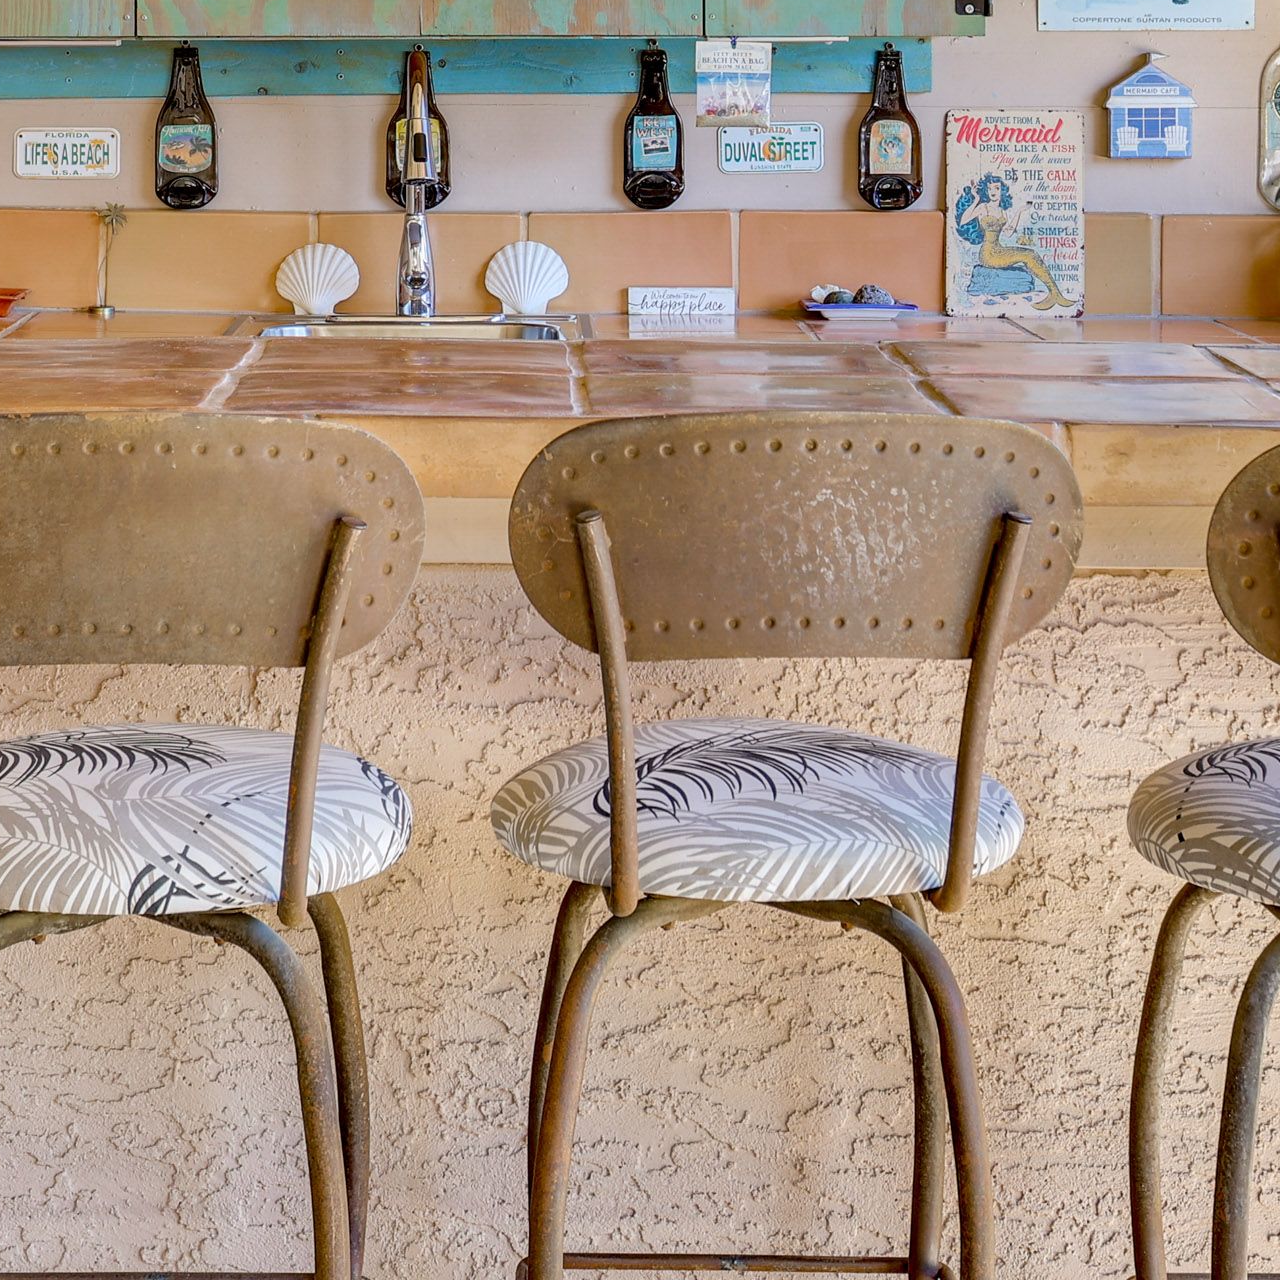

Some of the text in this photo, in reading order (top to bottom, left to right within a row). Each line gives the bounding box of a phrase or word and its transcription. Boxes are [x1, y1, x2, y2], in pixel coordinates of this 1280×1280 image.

[984, 116, 1041, 124] ADVICE FROM A
[953, 114, 1064, 149] Mermaid
[24, 142, 110, 165] LIFE'S A BEACH
[724, 141, 817, 162] DUVAL STREET
[979, 144, 1076, 153] DRINK LIKE A FISH
[990, 153, 1015, 166] Play
[1030, 153, 1044, 164] the
[1004, 169, 1077, 181] BE THE CALM
[1035, 181, 1050, 192] the
[1033, 202, 1078, 211] OF DEPTHS
[1023, 227, 1079, 236] IN SIMPLE
[1038, 237, 1077, 249] THINGS
[633, 292, 726, 315] happy place
